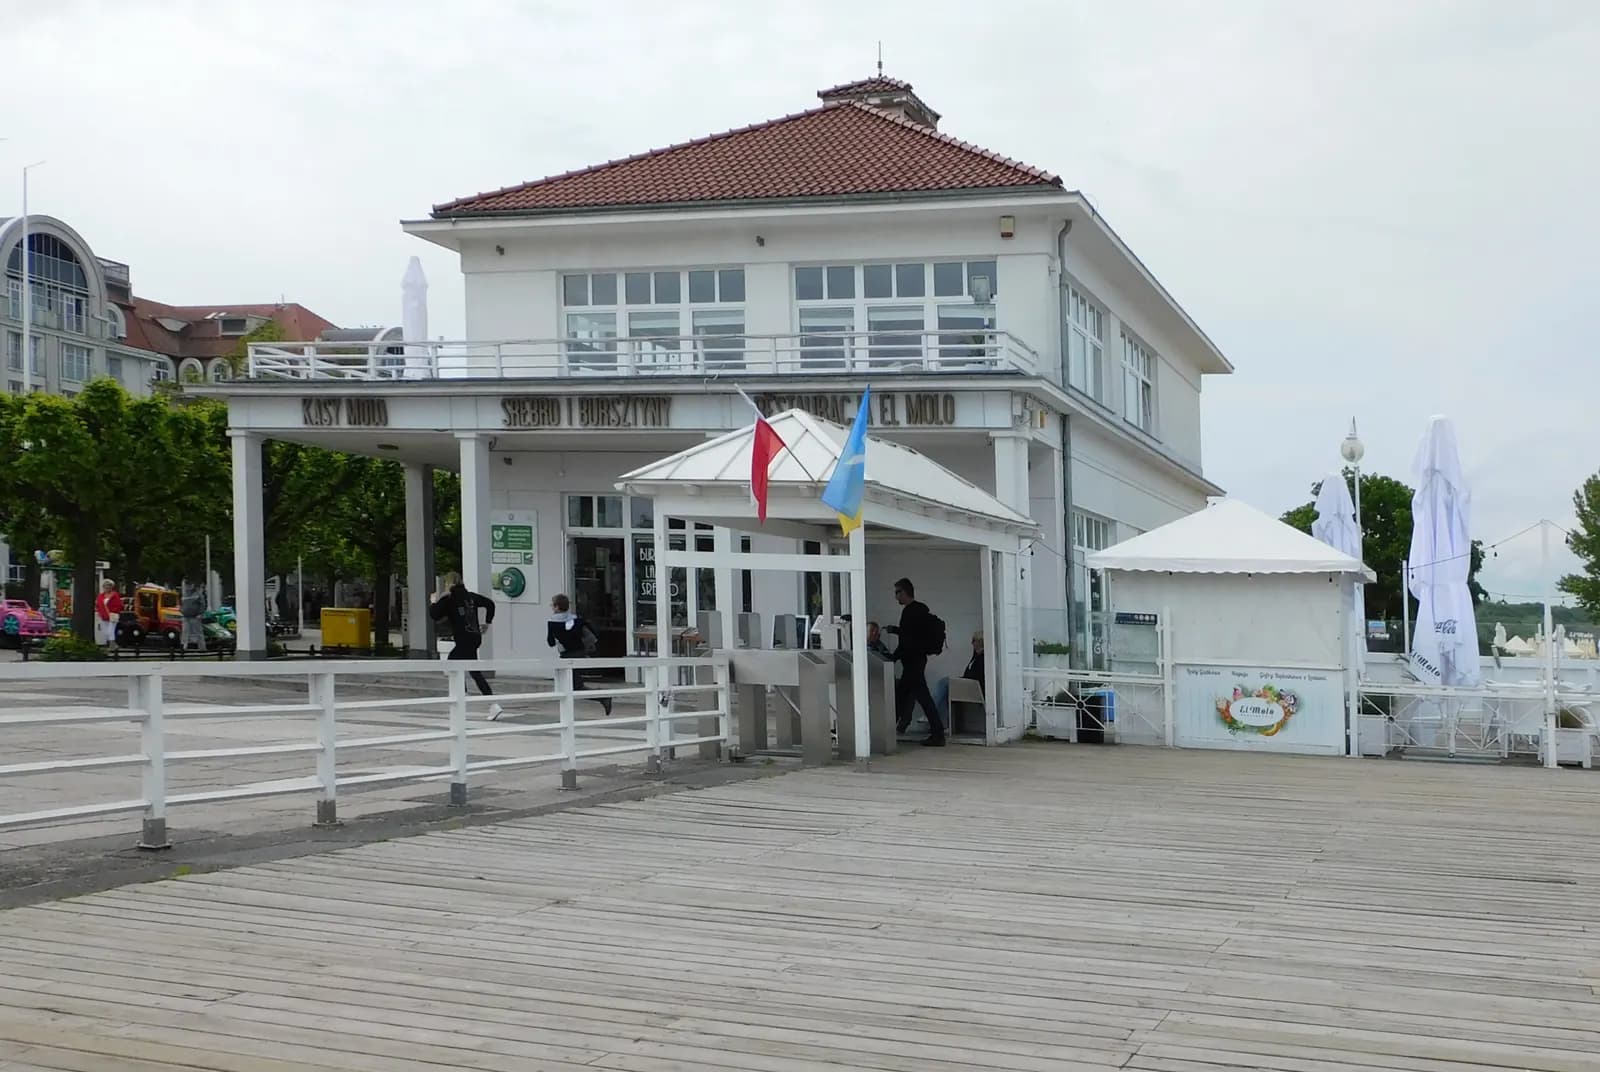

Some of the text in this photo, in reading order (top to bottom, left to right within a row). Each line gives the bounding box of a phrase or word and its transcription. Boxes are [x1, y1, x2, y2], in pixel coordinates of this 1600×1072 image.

[302, 398, 389, 426] KASY MOLO
[501, 395, 672, 427] SREBRO I BURSZTYNY
[879, 393, 900, 426] EL
[905, 393, 955, 425] MOLO
